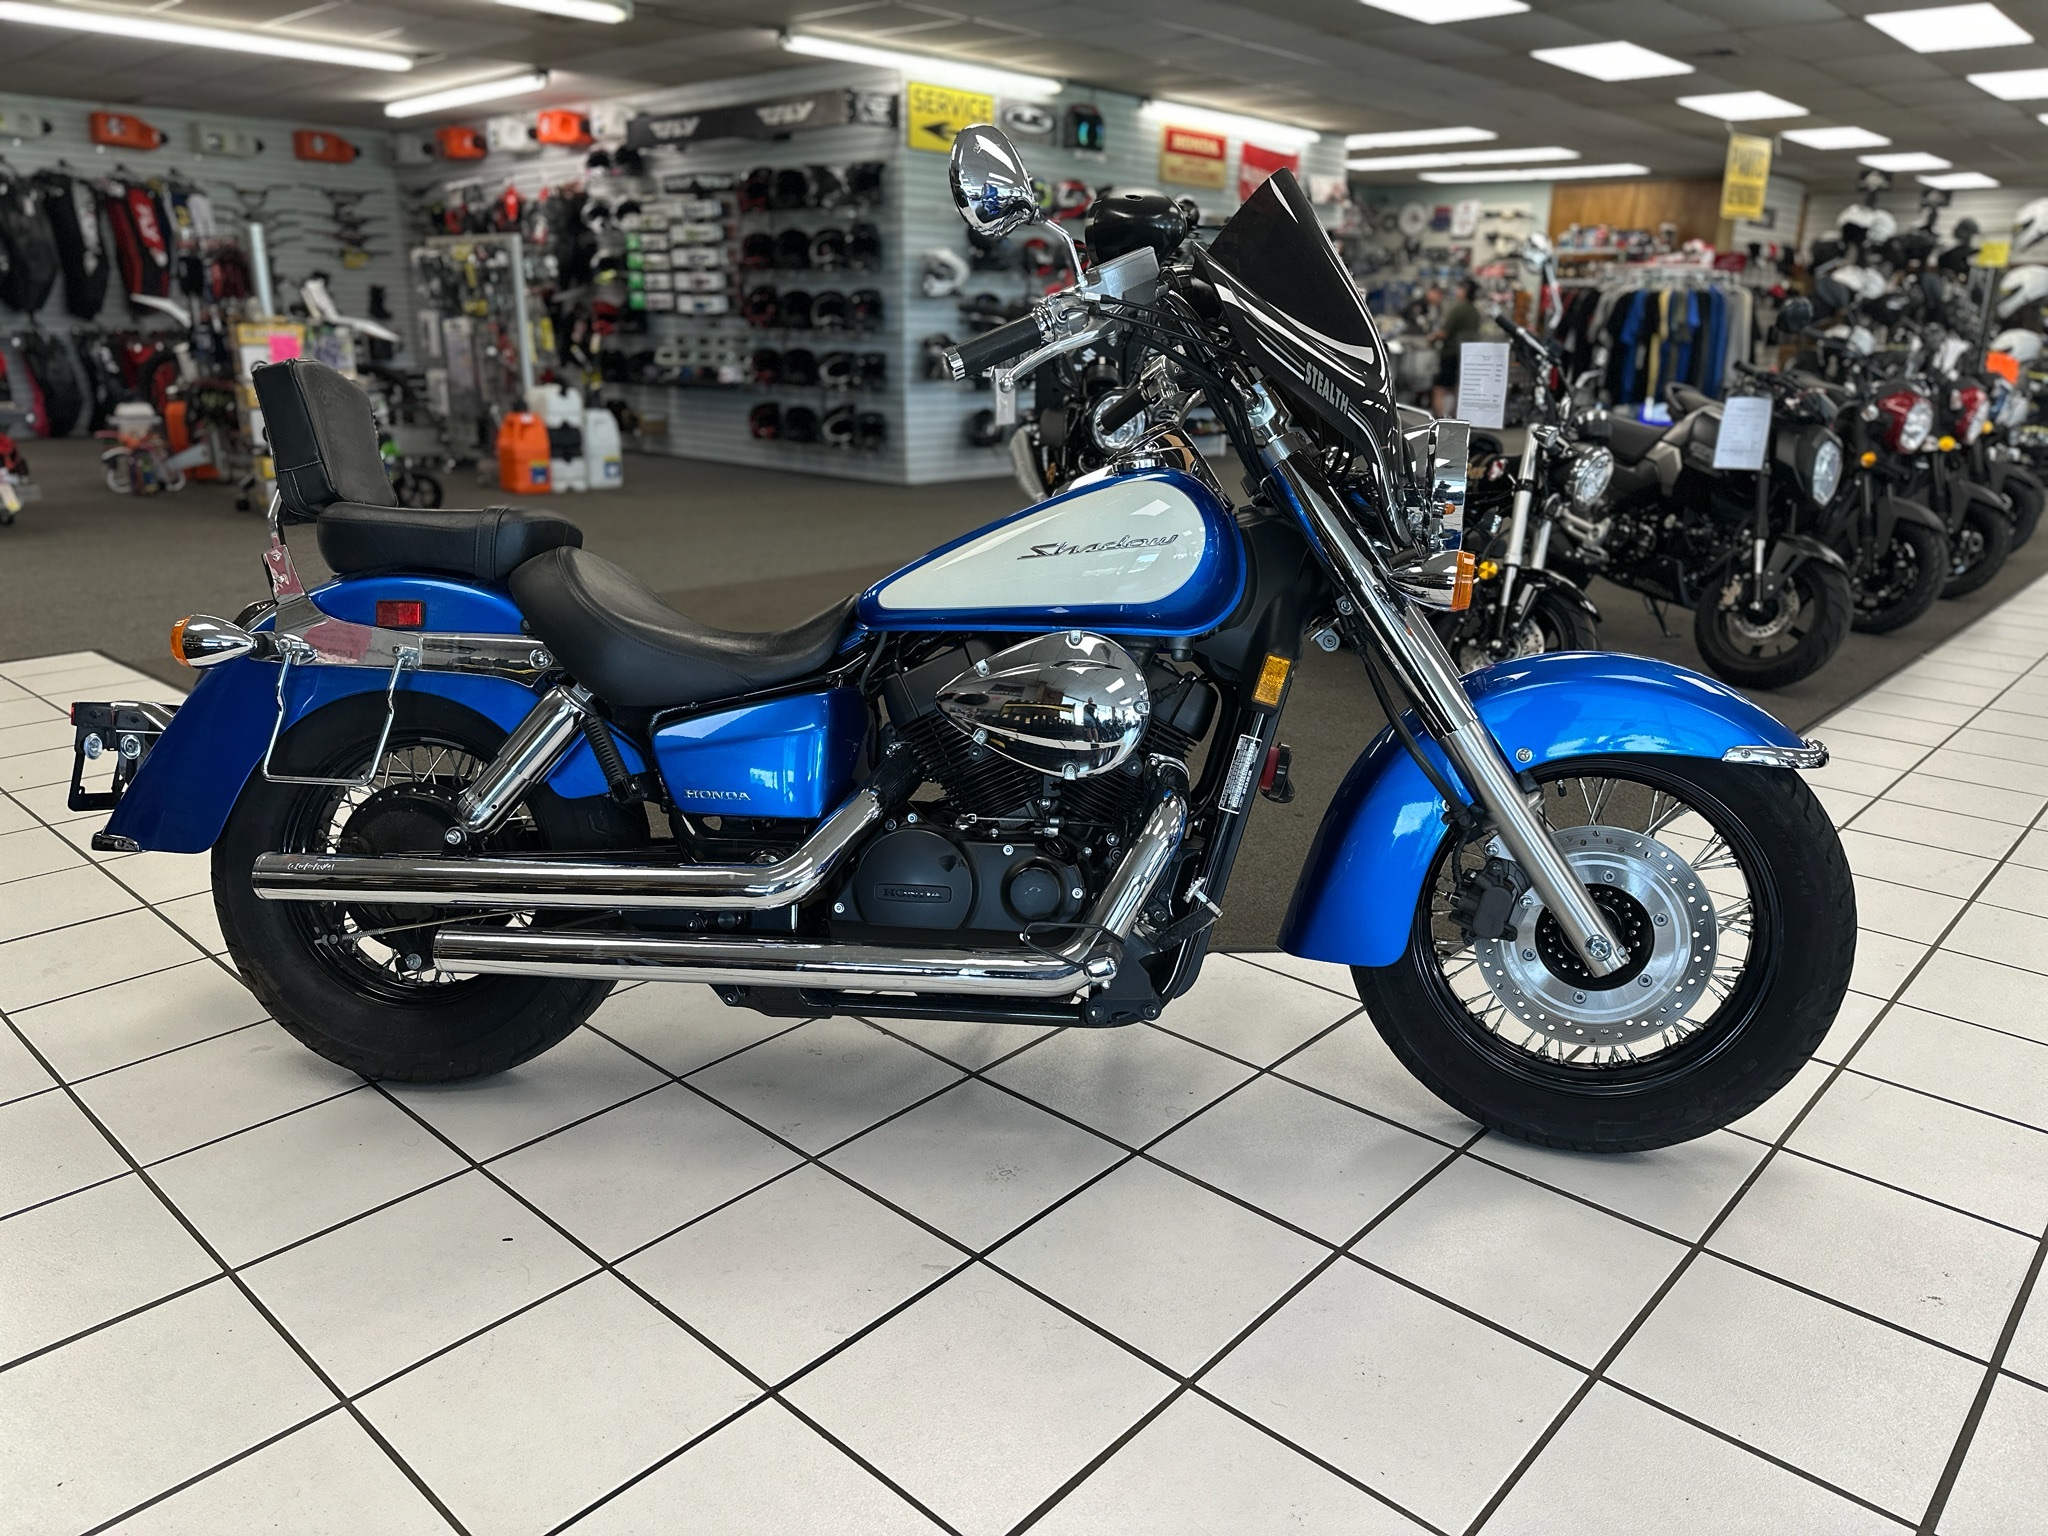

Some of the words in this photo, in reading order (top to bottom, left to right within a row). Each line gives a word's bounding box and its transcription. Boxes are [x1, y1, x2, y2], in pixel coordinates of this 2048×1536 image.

[913, 87, 990, 123] SERVICE
[1305, 362, 1349, 415] STEALTH
[1017, 535, 1178, 560] Shadow
[684, 790, 751, 801] HONDA
